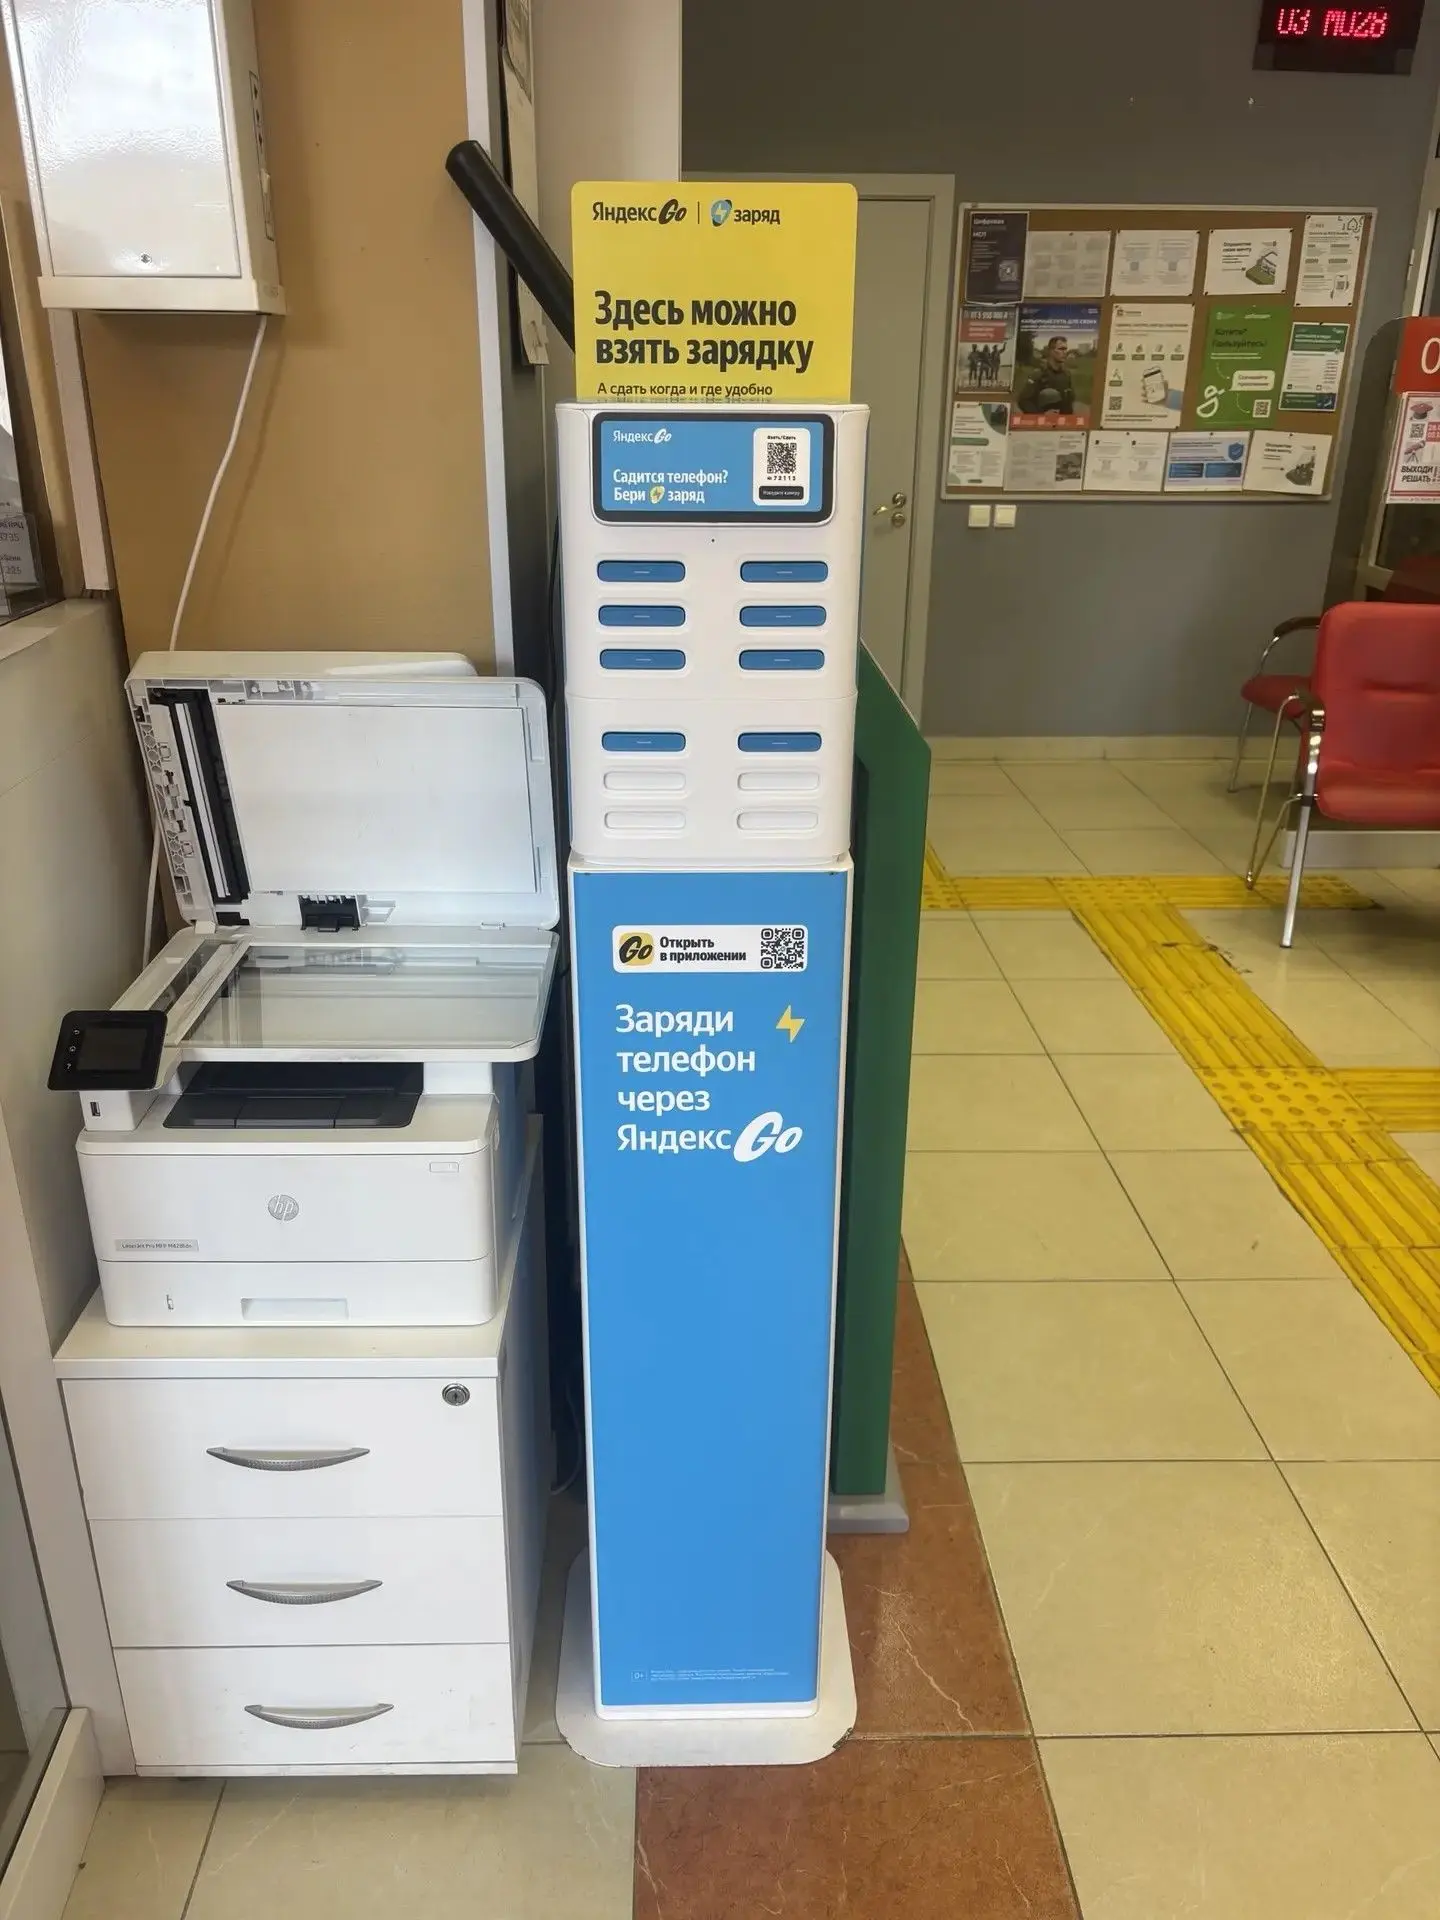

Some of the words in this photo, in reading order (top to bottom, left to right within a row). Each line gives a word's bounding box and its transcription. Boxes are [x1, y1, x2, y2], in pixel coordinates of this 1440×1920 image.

[592, 202, 657, 223] Яндекс
[658, 198, 687, 225] Go
[734, 209, 780, 225] заряд
[594, 290, 684, 331] Здесь
[691, 300, 797, 326] можно
[596, 339, 680, 364] взять
[686, 339, 814, 374] зарядку
[598, 383, 607, 394] А
[610, 385, 647, 396] сдать
[650, 385, 686, 396] когда
[690, 385, 697, 394] и
[701, 385, 722, 396] где
[725, 384, 773, 397] удобно
[613, 430, 653, 443] Яндекс
[654, 428, 672, 444] Go
[613, 469, 664, 485] Садится
[667, 469, 729, 487] телефон?
[614, 487, 646, 504] Бери
[668, 490, 705, 504] заряд
[619, 935, 653, 964] Go
[660, 936, 715, 951] Открыть
[660, 952, 668, 961] в
[669, 951, 747, 964] приложении
[615, 1004, 734, 1038] Заряди
[617, 1044, 756, 1077] телефон
[617, 1089, 711, 1116] через
[617, 1123, 732, 1154] Яндекс
[733, 1111, 803, 1163] Go
